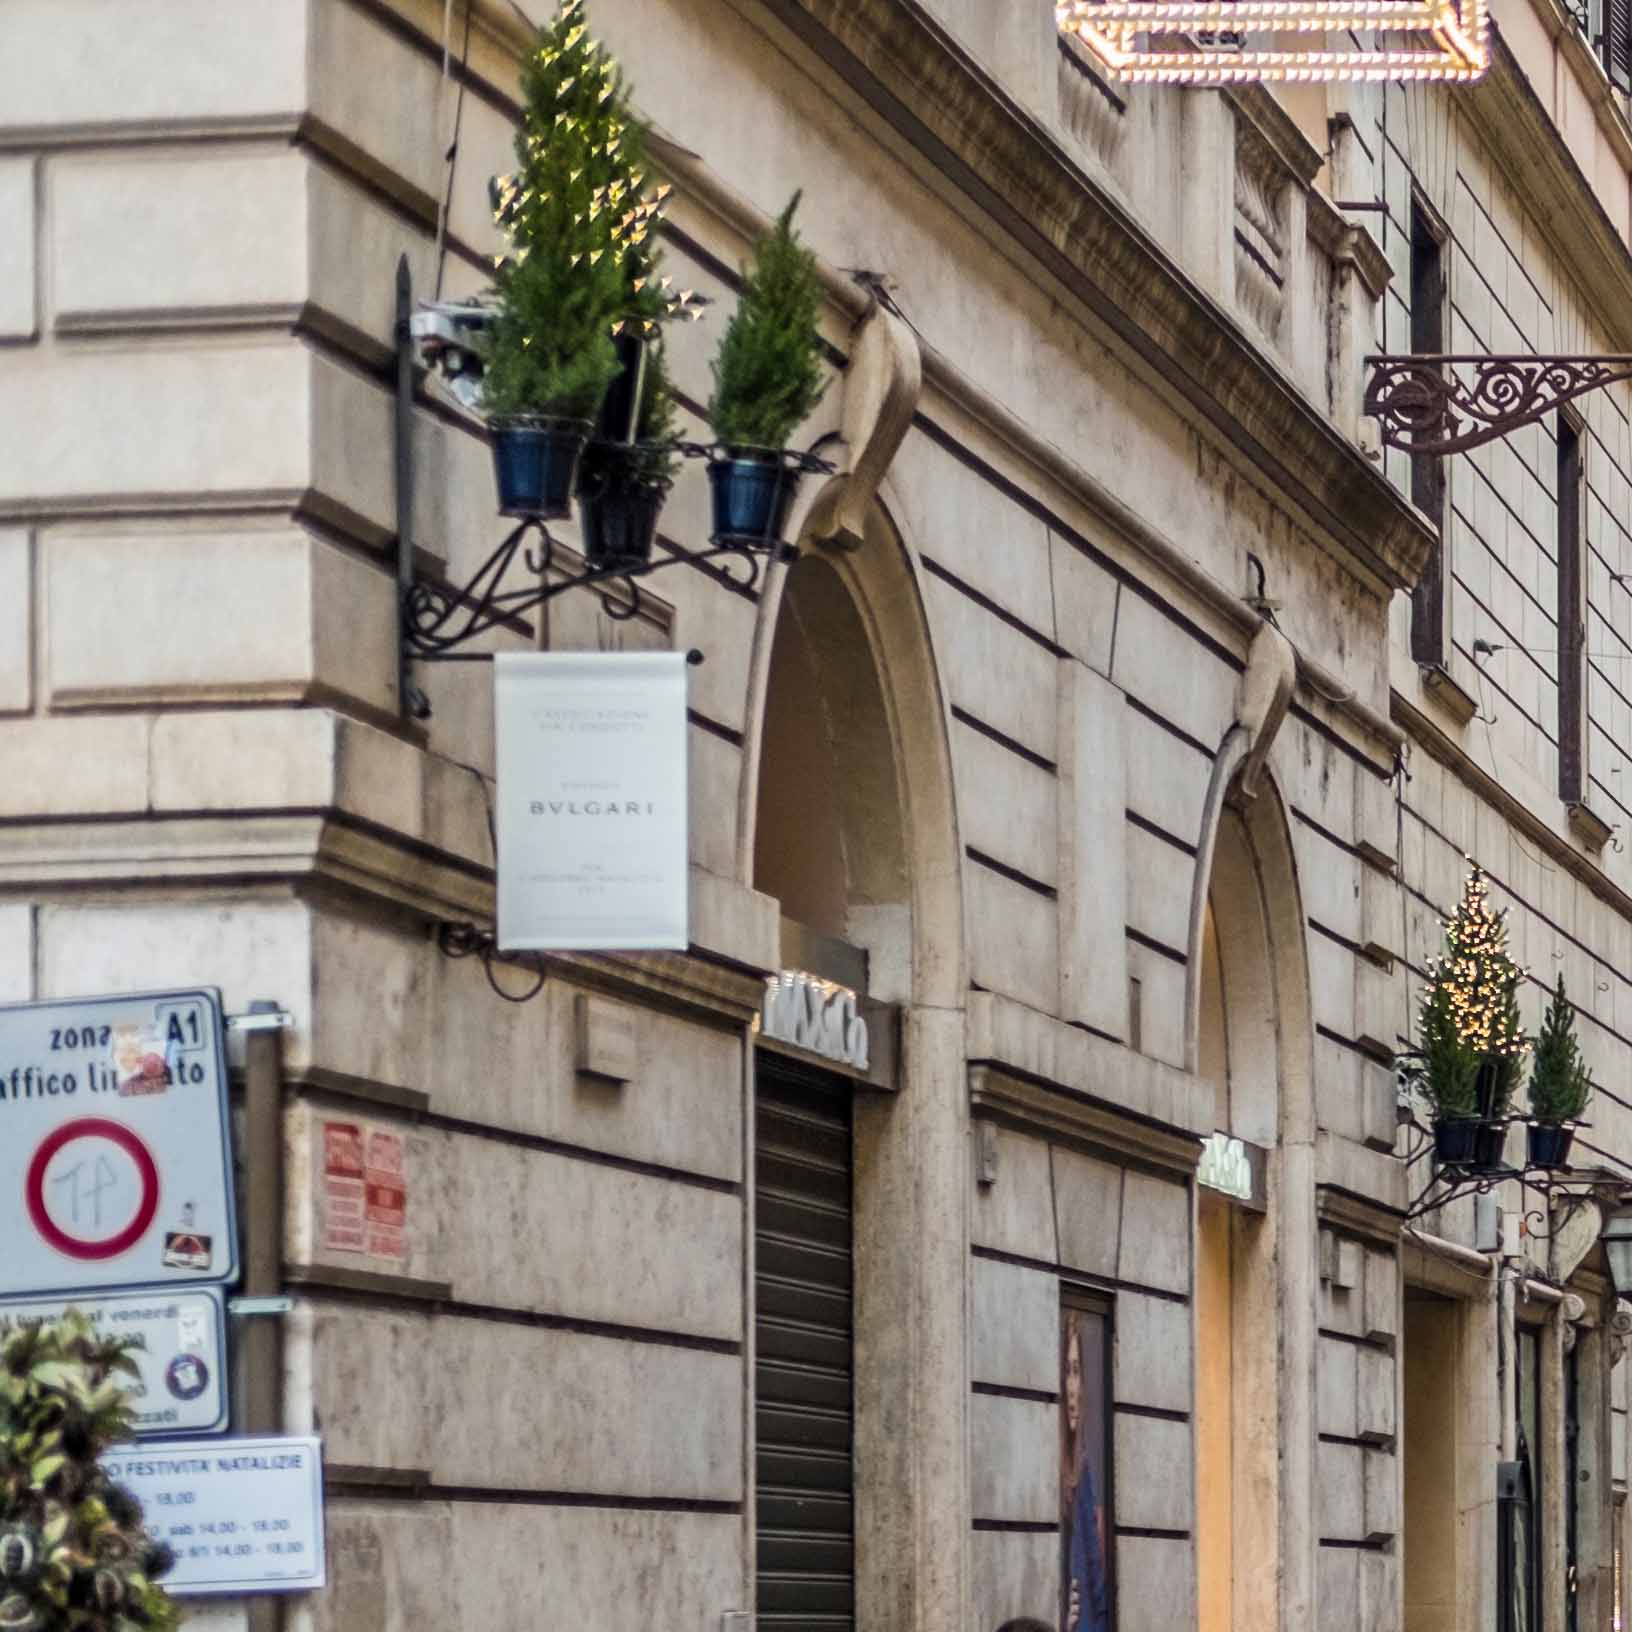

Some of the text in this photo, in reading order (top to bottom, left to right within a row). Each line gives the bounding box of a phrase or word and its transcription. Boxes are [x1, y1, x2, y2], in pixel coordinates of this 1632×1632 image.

[529, 800, 655, 816] BVLGARI
[167, 1009, 199, 1044] A1
[88, 1056, 205, 1093] lito
[216, 1455, 303, 1472] NATALIZIE
